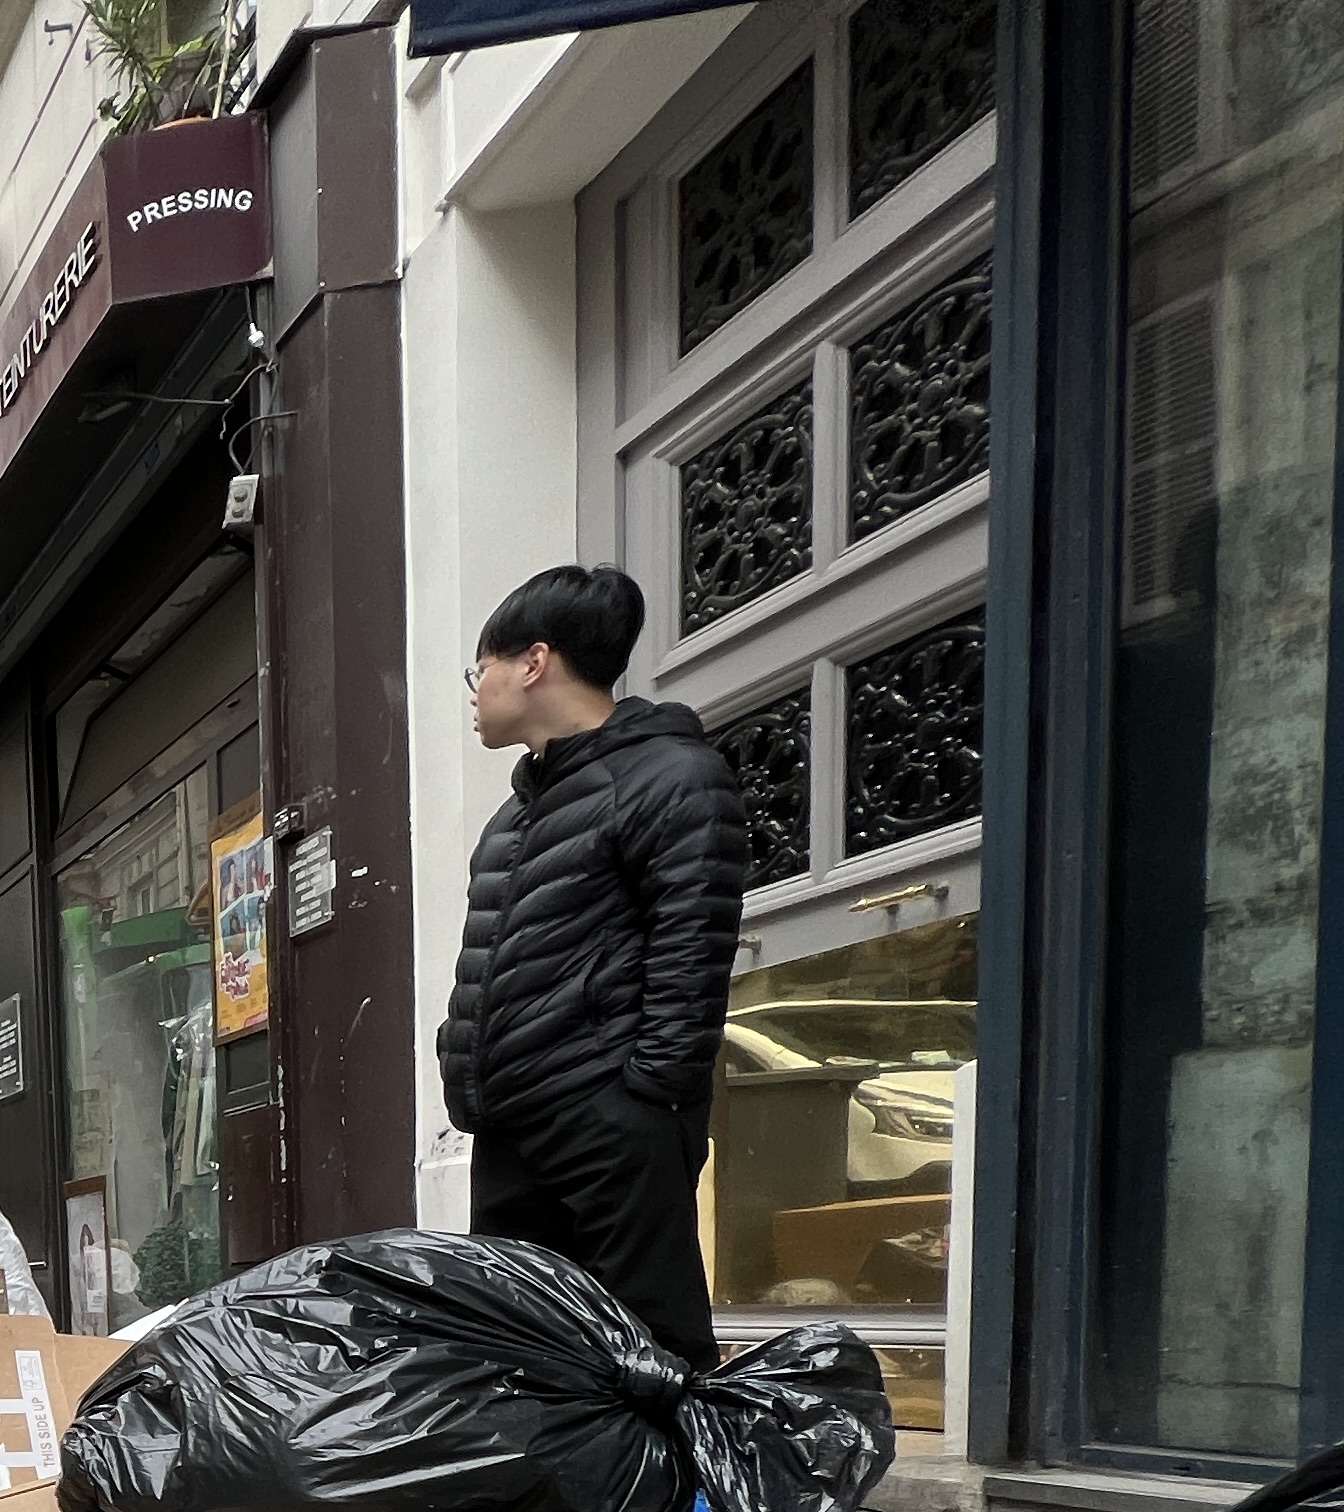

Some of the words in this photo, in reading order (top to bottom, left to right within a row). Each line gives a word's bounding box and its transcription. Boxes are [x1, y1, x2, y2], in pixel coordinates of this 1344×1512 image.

[126, 188, 253, 232] PRESSING
[31, 1396, 45, 1412] UP
[34, 1412, 51, 1440] SIDE
[40, 1441, 56, 1468] THIS
